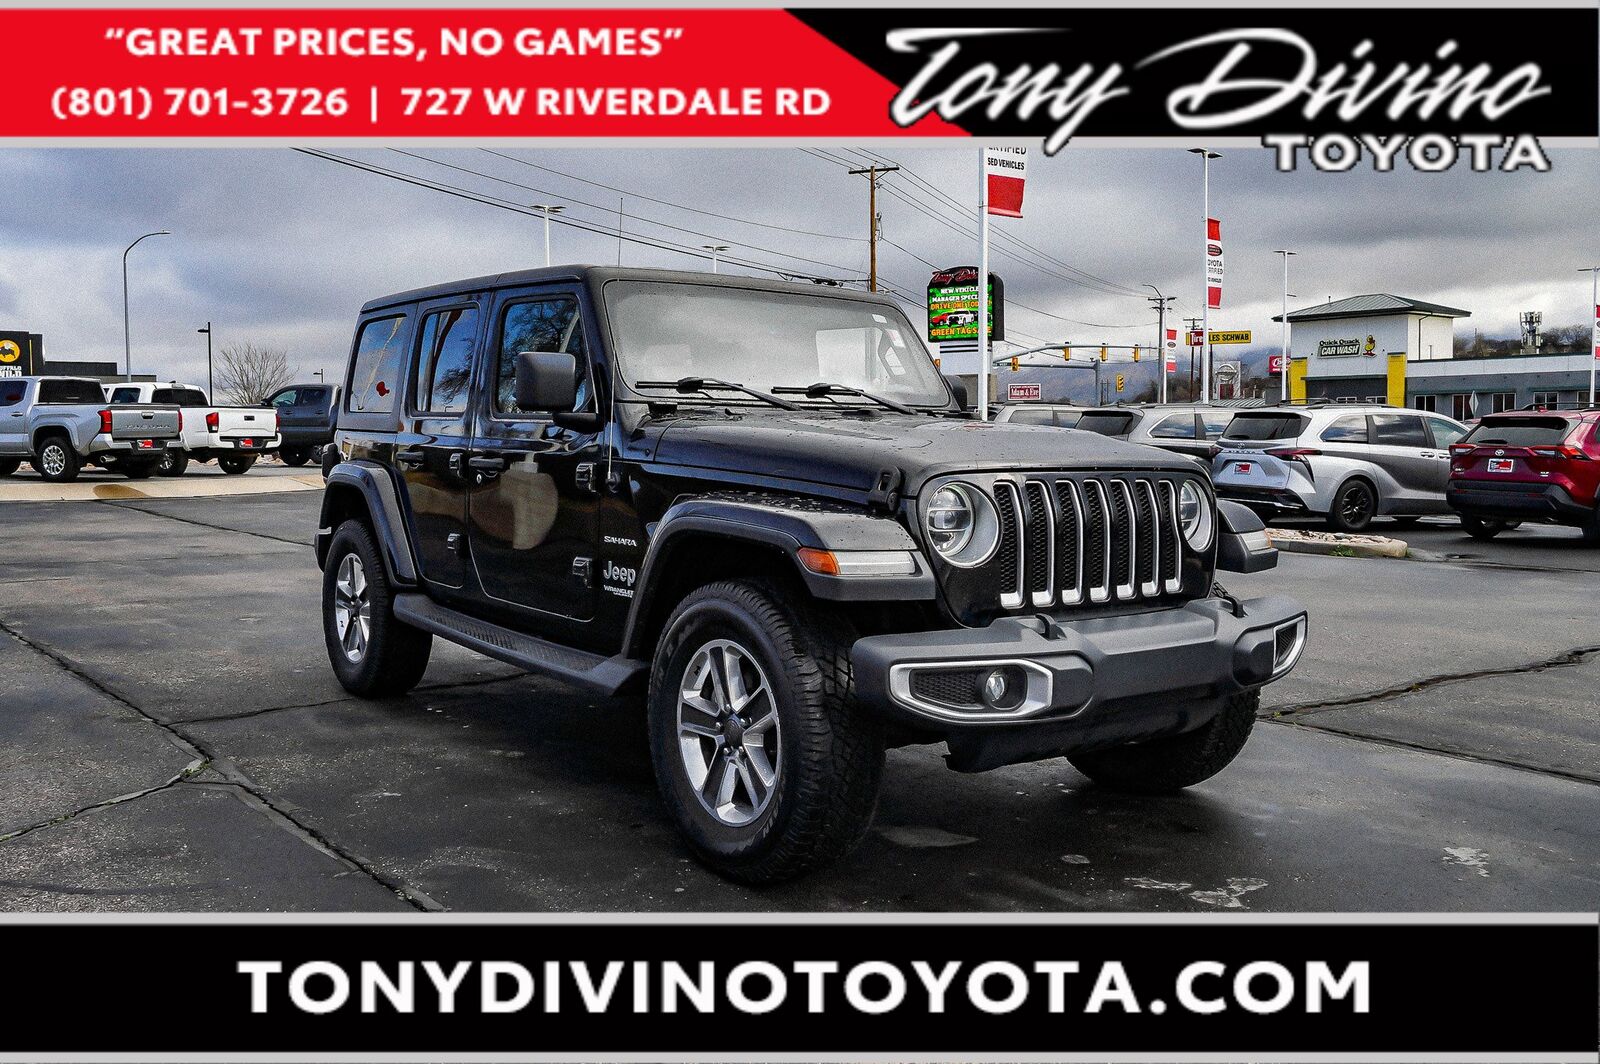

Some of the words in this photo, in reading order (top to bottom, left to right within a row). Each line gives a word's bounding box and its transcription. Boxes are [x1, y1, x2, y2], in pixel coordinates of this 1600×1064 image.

[987, 157, 998, 166] SED
[999, 158, 1025, 170] VEHICLES
[1208, 260, 1222, 268] OYOTA
[930, 302, 952, 310] DRIVE
[930, 328, 955, 336] GREEN
[1222, 333, 1250, 342] SCHWAB
[1322, 347, 1336, 356] CAR
[1337, 344, 1360, 354] WASH
[604, 535, 638, 547] SAHARA
[603, 560, 636, 586] Jeep
